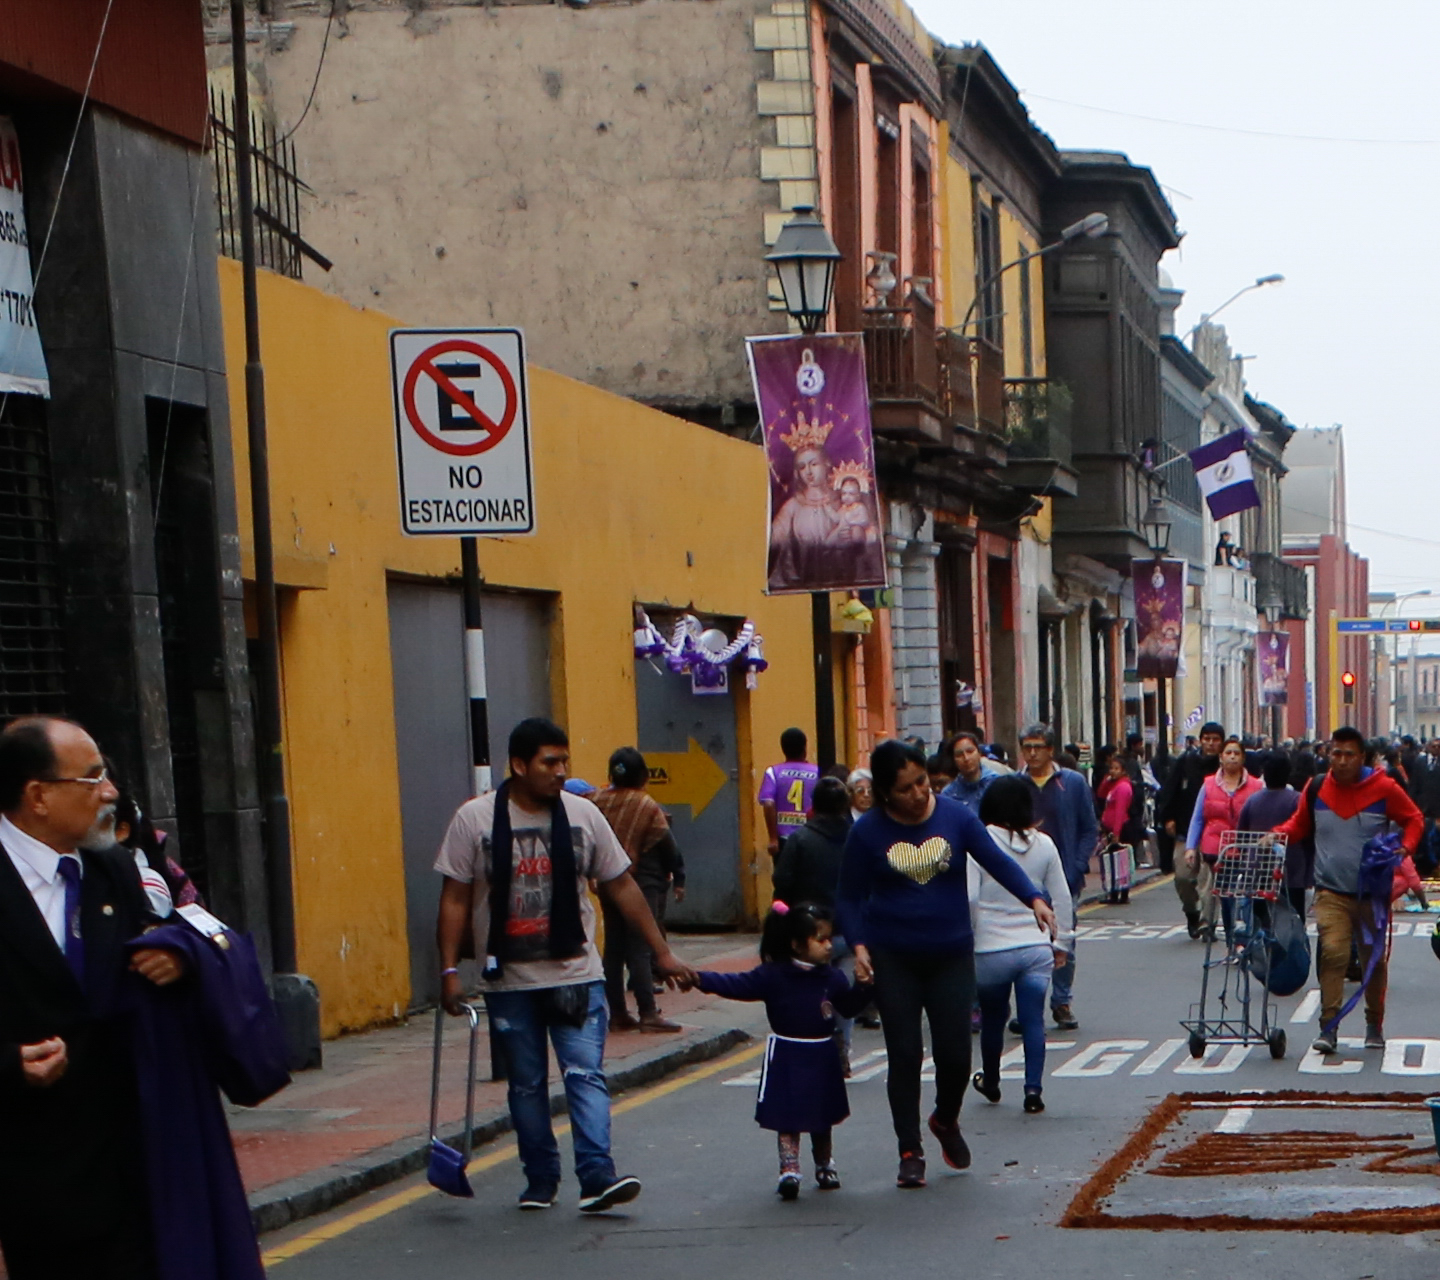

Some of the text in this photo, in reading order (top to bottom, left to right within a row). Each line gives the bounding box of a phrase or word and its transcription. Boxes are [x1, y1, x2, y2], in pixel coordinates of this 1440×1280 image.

[802, 369, 816, 389] 3
[448, 465, 483, 490] NO
[409, 498, 527, 525] ESTACIONAR
[787, 779, 803, 811] 4
